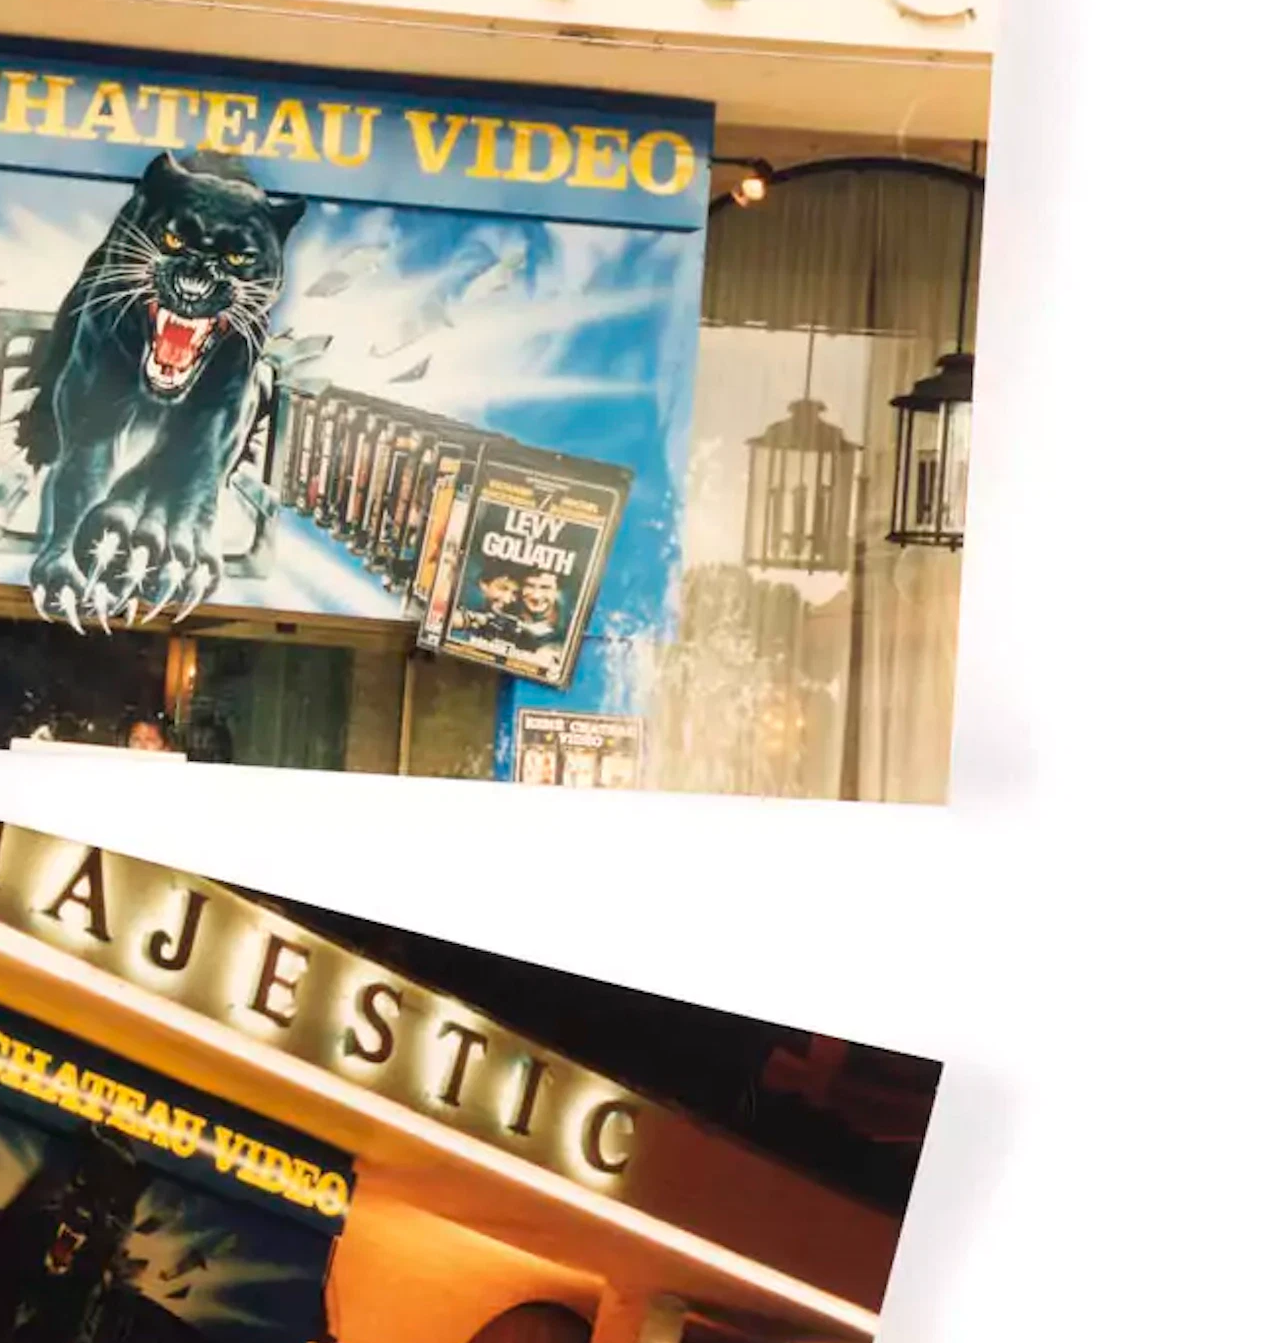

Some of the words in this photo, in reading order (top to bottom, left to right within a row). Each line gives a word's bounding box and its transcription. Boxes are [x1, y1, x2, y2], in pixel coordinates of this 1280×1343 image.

[404, 110, 696, 196] VIDEO
[482, 532, 577, 576] GOLIATH
[504, 507, 567, 543] LEVY
[213, 1125, 349, 1216] VIDEO
